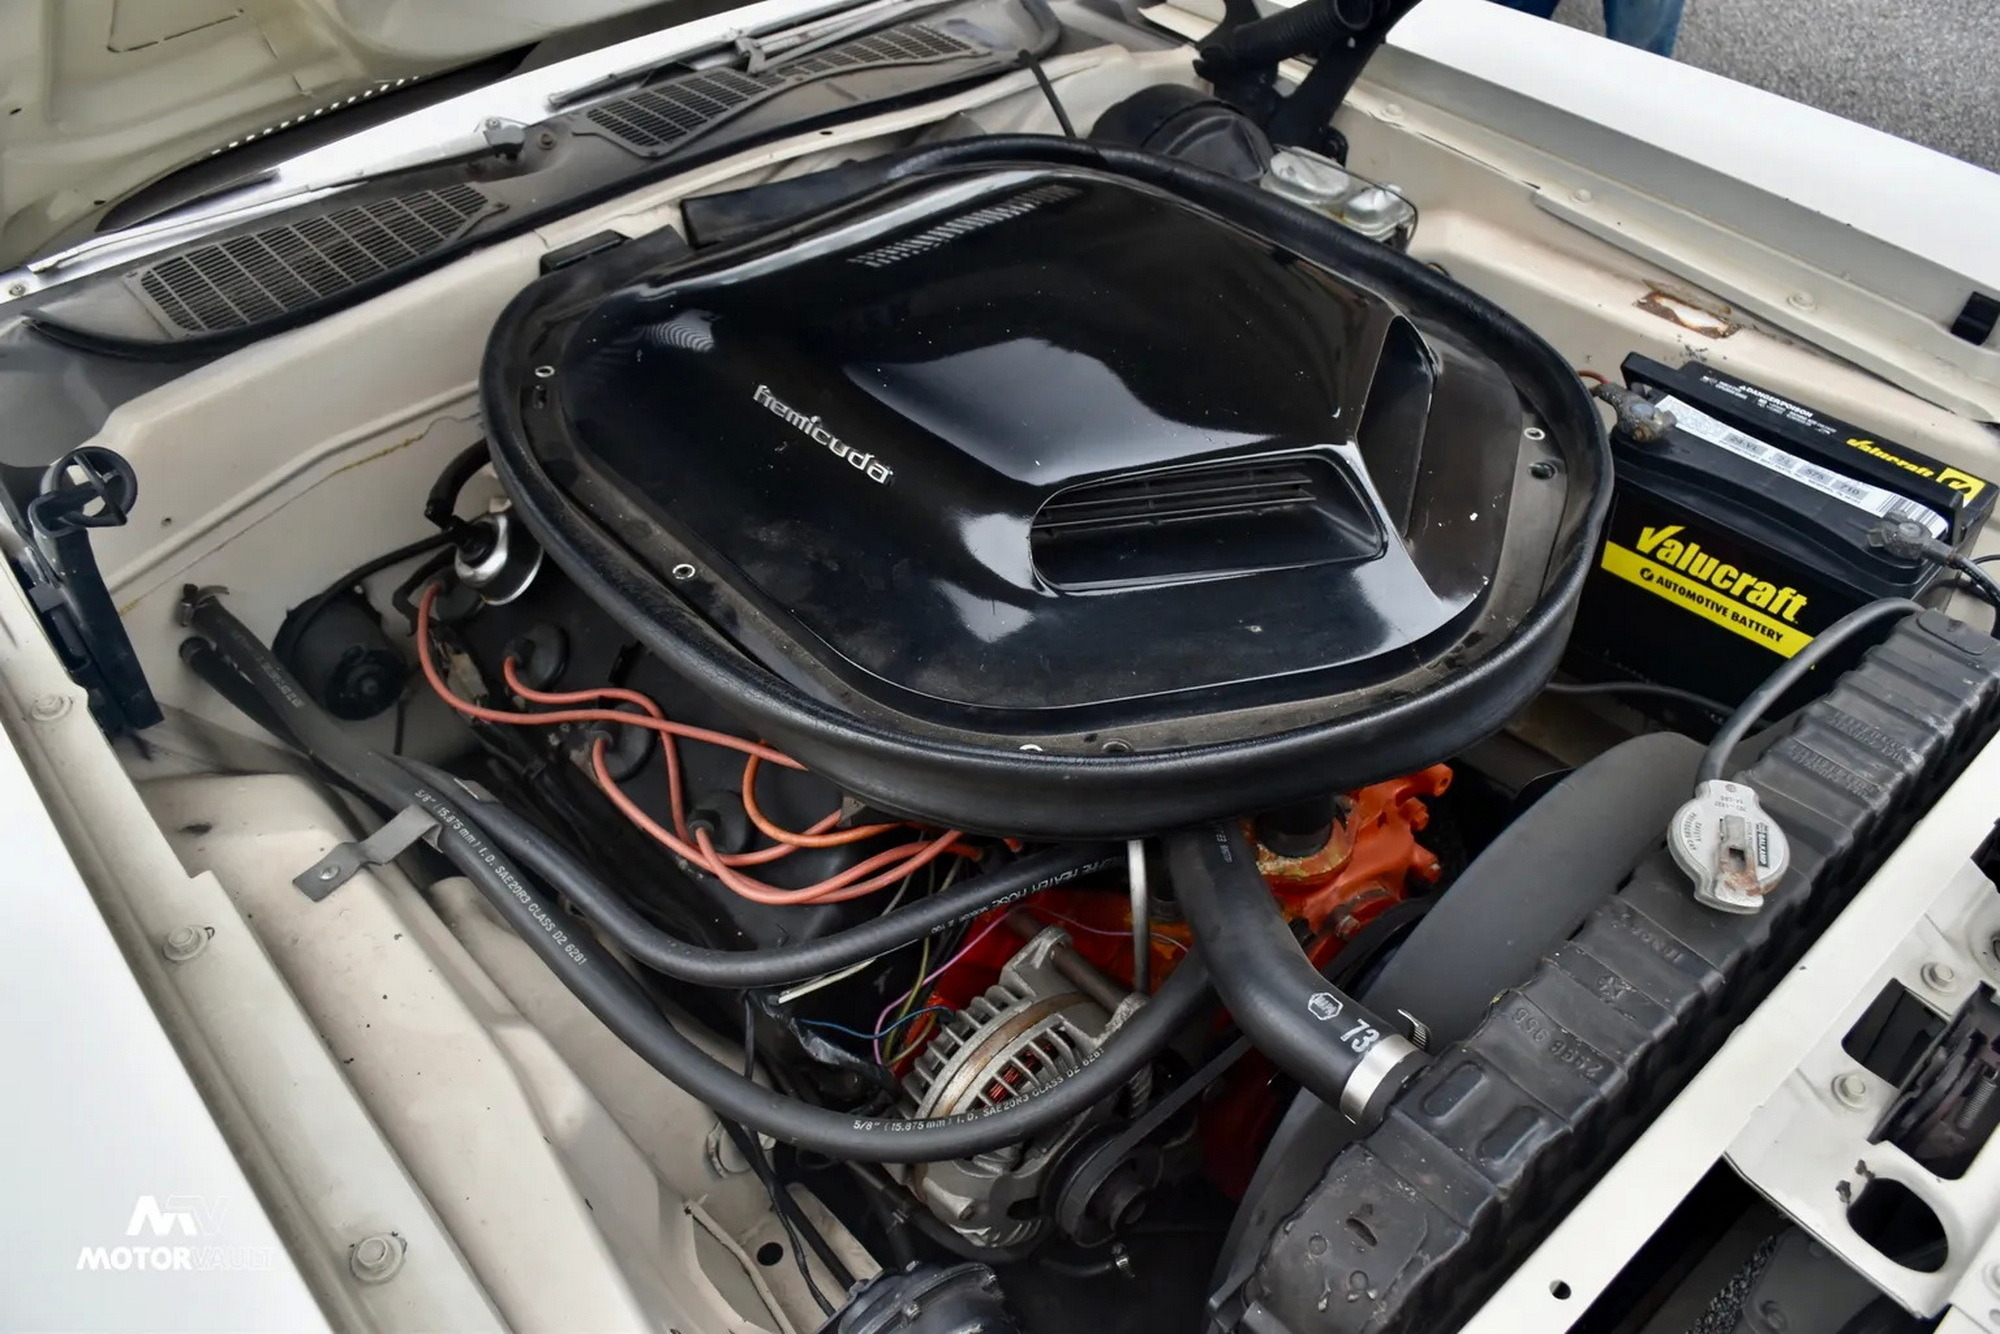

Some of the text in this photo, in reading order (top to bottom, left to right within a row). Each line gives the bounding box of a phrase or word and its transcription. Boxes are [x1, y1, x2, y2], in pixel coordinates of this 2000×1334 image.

[1636, 525, 1807, 622] Valucraft
[1655, 575, 1783, 643] AUTOMOTIVE BATTERY
[494, 865, 531, 904] SAE20R3
[528, 903, 556, 932] CLASS
[552, 930, 568, 946] D2
[983, 1092, 1030, 1118] SAE20R3
[1032, 1075, 1064, 1098] CLASS
